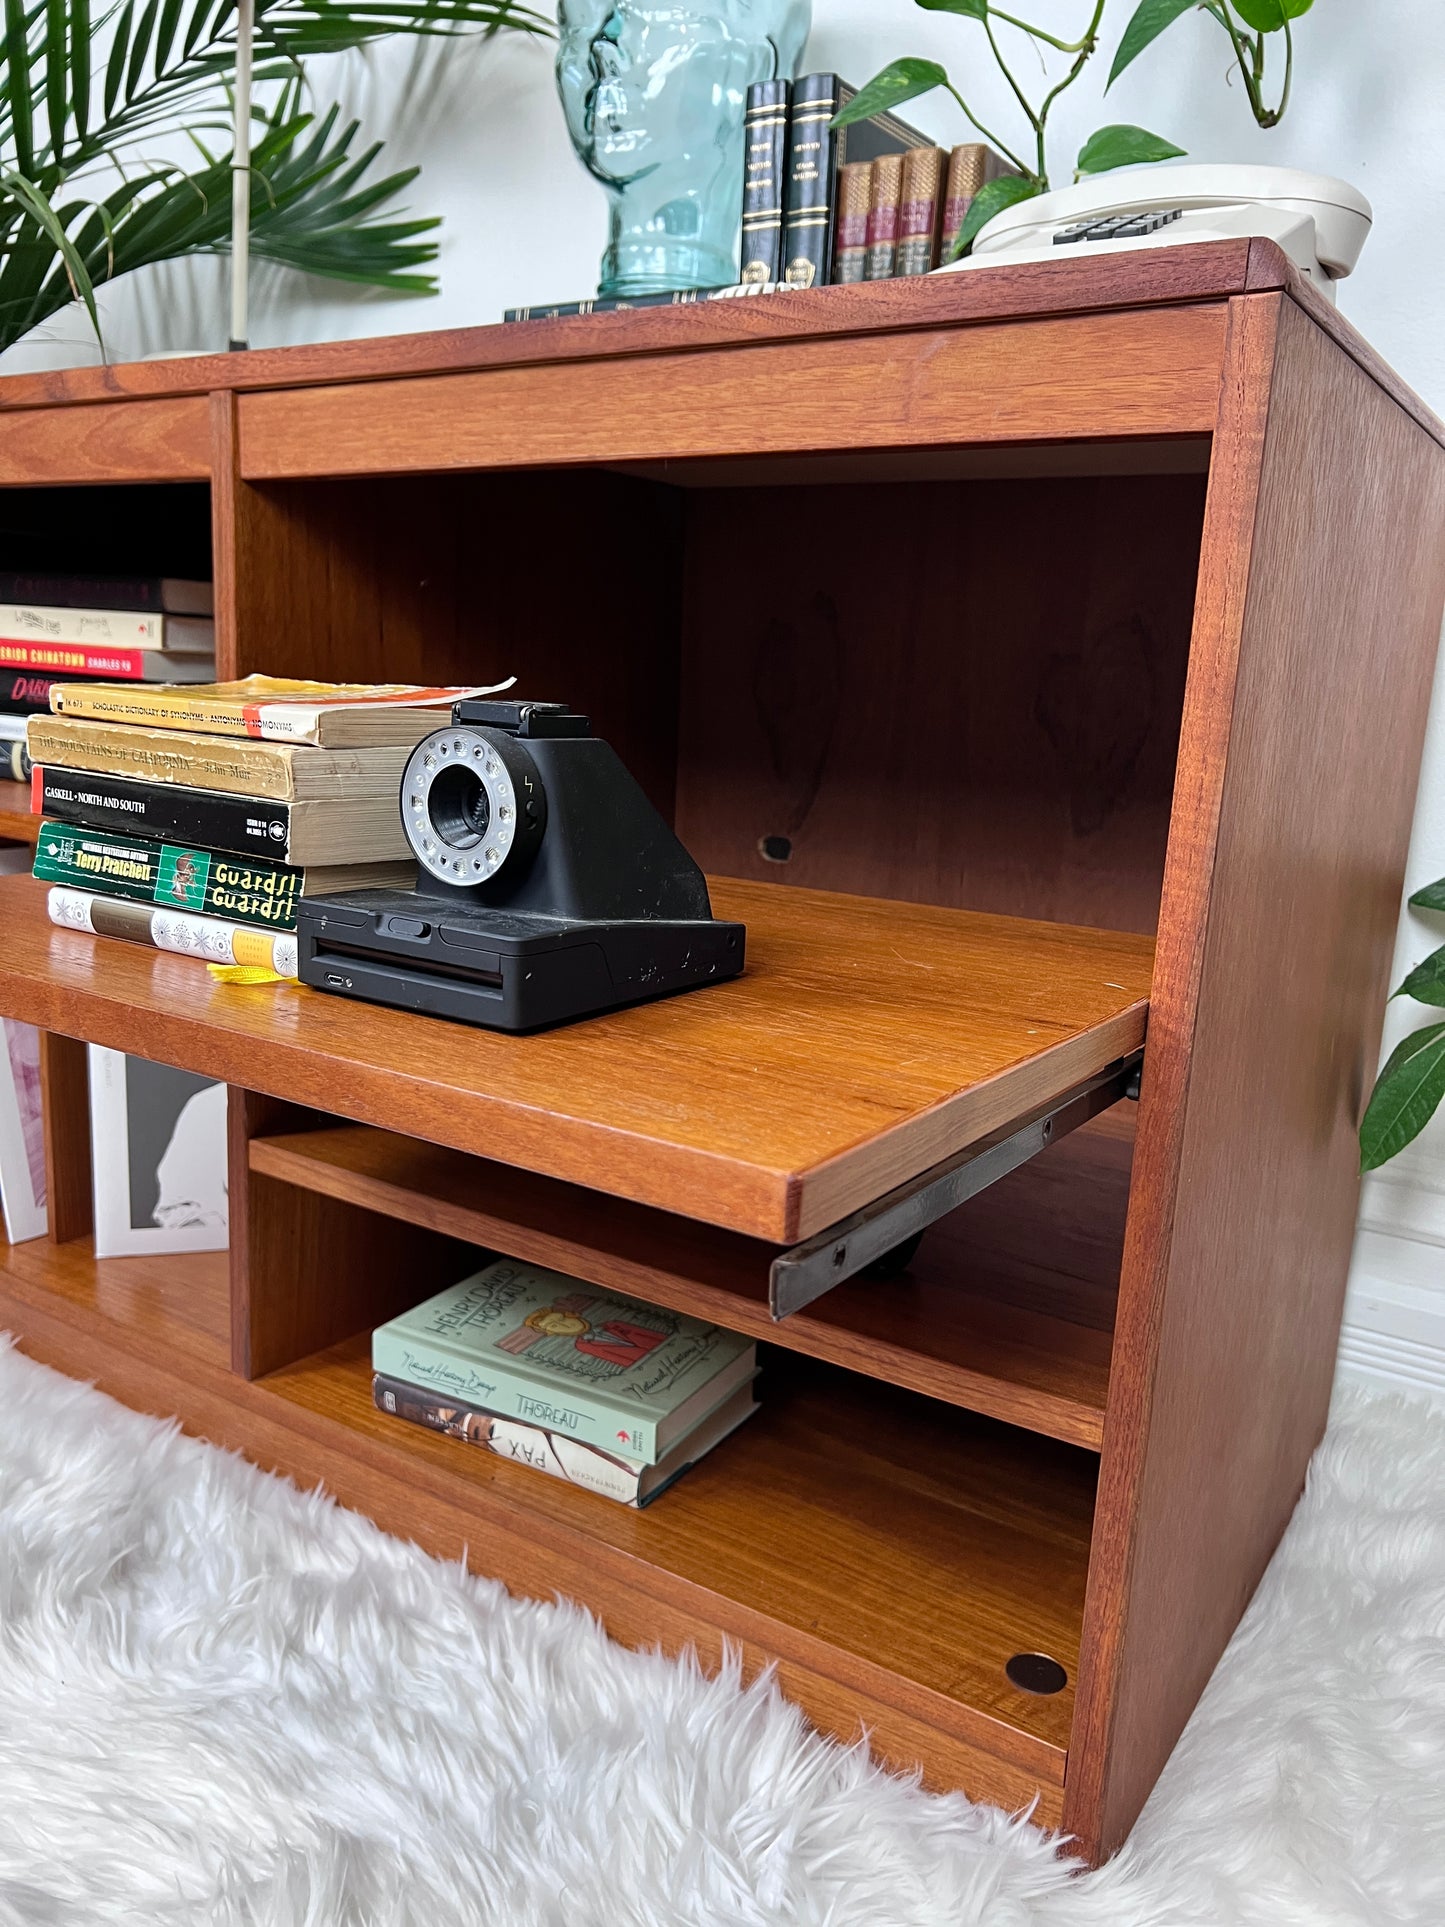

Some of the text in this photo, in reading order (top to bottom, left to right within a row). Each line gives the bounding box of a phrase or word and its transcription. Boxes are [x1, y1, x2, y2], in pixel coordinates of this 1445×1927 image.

[30, 649, 85, 668] CHINATOWN
[87, 657, 120, 670] CHARLES
[92, 702, 293, 732] SCHOLASTIC DICTIONARY OF SYNONYMS ANTONYMS HOMONYMS
[39, 738, 56, 749] THE
[60, 740, 113, 759] MOUNTAINS
[132, 750, 190, 770] CALIFORNIA
[204, 762, 227, 776] John
[229, 765, 251, 780] Muir
[45, 787, 145, 813] GASKELL NORTH AND SOUTH
[76, 850, 102, 873] Terry
[102, 856, 151, 881] Pratchett
[216, 863, 296, 897] Guards!
[212, 886, 293, 921] Guards!
[424, 1268, 515, 1336] HENRY DAVID
[462, 1283, 527, 1330] THOREAU
[516, 1393, 584, 1430] THOREAU
[508, 1439, 546, 1469] PAX
